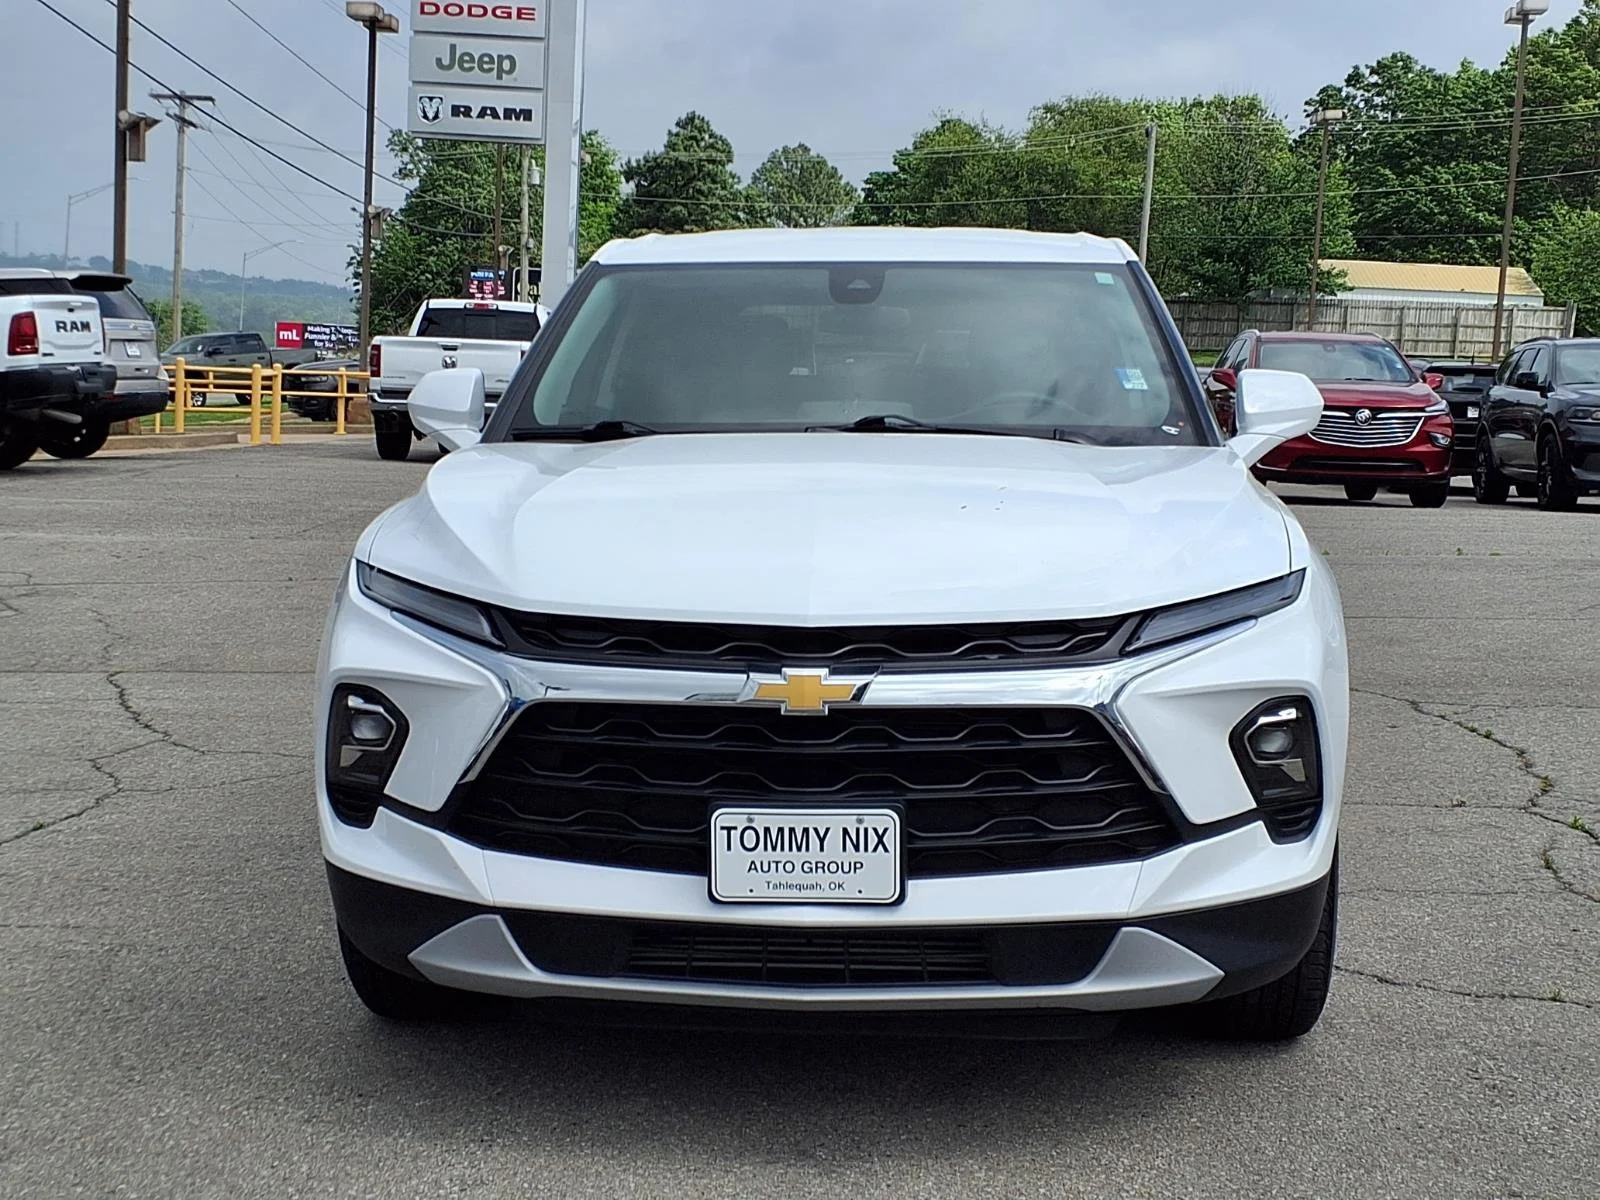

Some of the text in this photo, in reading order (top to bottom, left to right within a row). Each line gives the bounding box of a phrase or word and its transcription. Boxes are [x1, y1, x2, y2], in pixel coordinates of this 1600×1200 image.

[419, 1, 536, 21] DODGE
[435, 43, 517, 80] Jeep
[450, 104, 533, 122] RAM
[55, 320, 91, 333] RAM
[307, 326, 330, 334] Making
[279, 329, 300, 340] mL
[720, 825, 890, 853] TOMMY NIX
[747, 860, 864, 875] AUTO GROUP
[765, 881, 845, 893] Tahlequah, OK
